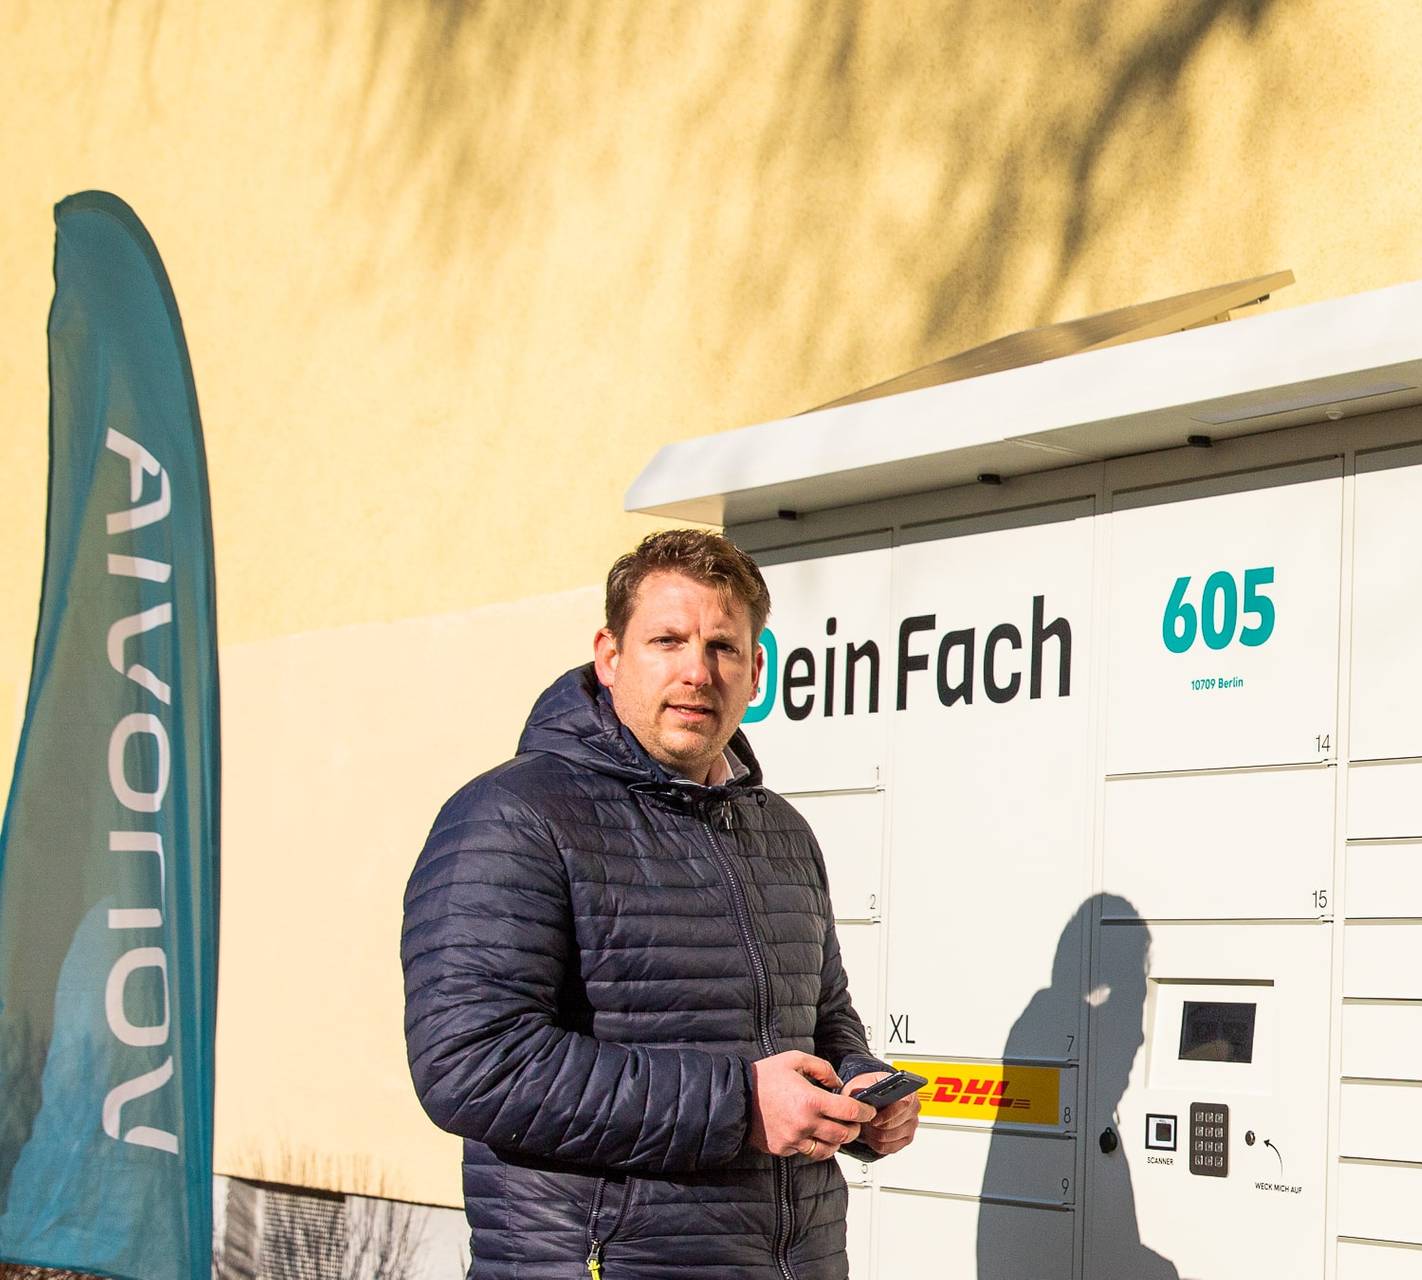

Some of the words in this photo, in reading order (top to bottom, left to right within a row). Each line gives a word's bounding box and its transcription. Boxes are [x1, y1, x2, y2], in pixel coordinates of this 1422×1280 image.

[1163, 567, 1275, 653] 605
[1191, 679, 1216, 691] 10709
[1218, 677, 1244, 689] Berlin
[1316, 735, 1330, 752] 14
[869, 894, 877, 910] 2
[1313, 890, 1327, 908] 15
[889, 1014, 915, 1044] XL
[1066, 1035, 1075, 1052] 7
[931, 1077, 1016, 1108] DHL
[1063, 1107, 1071, 1123] 8
[1147, 1157, 1174, 1166] SCANNER
[1061, 1178, 1069, 1195] 9
